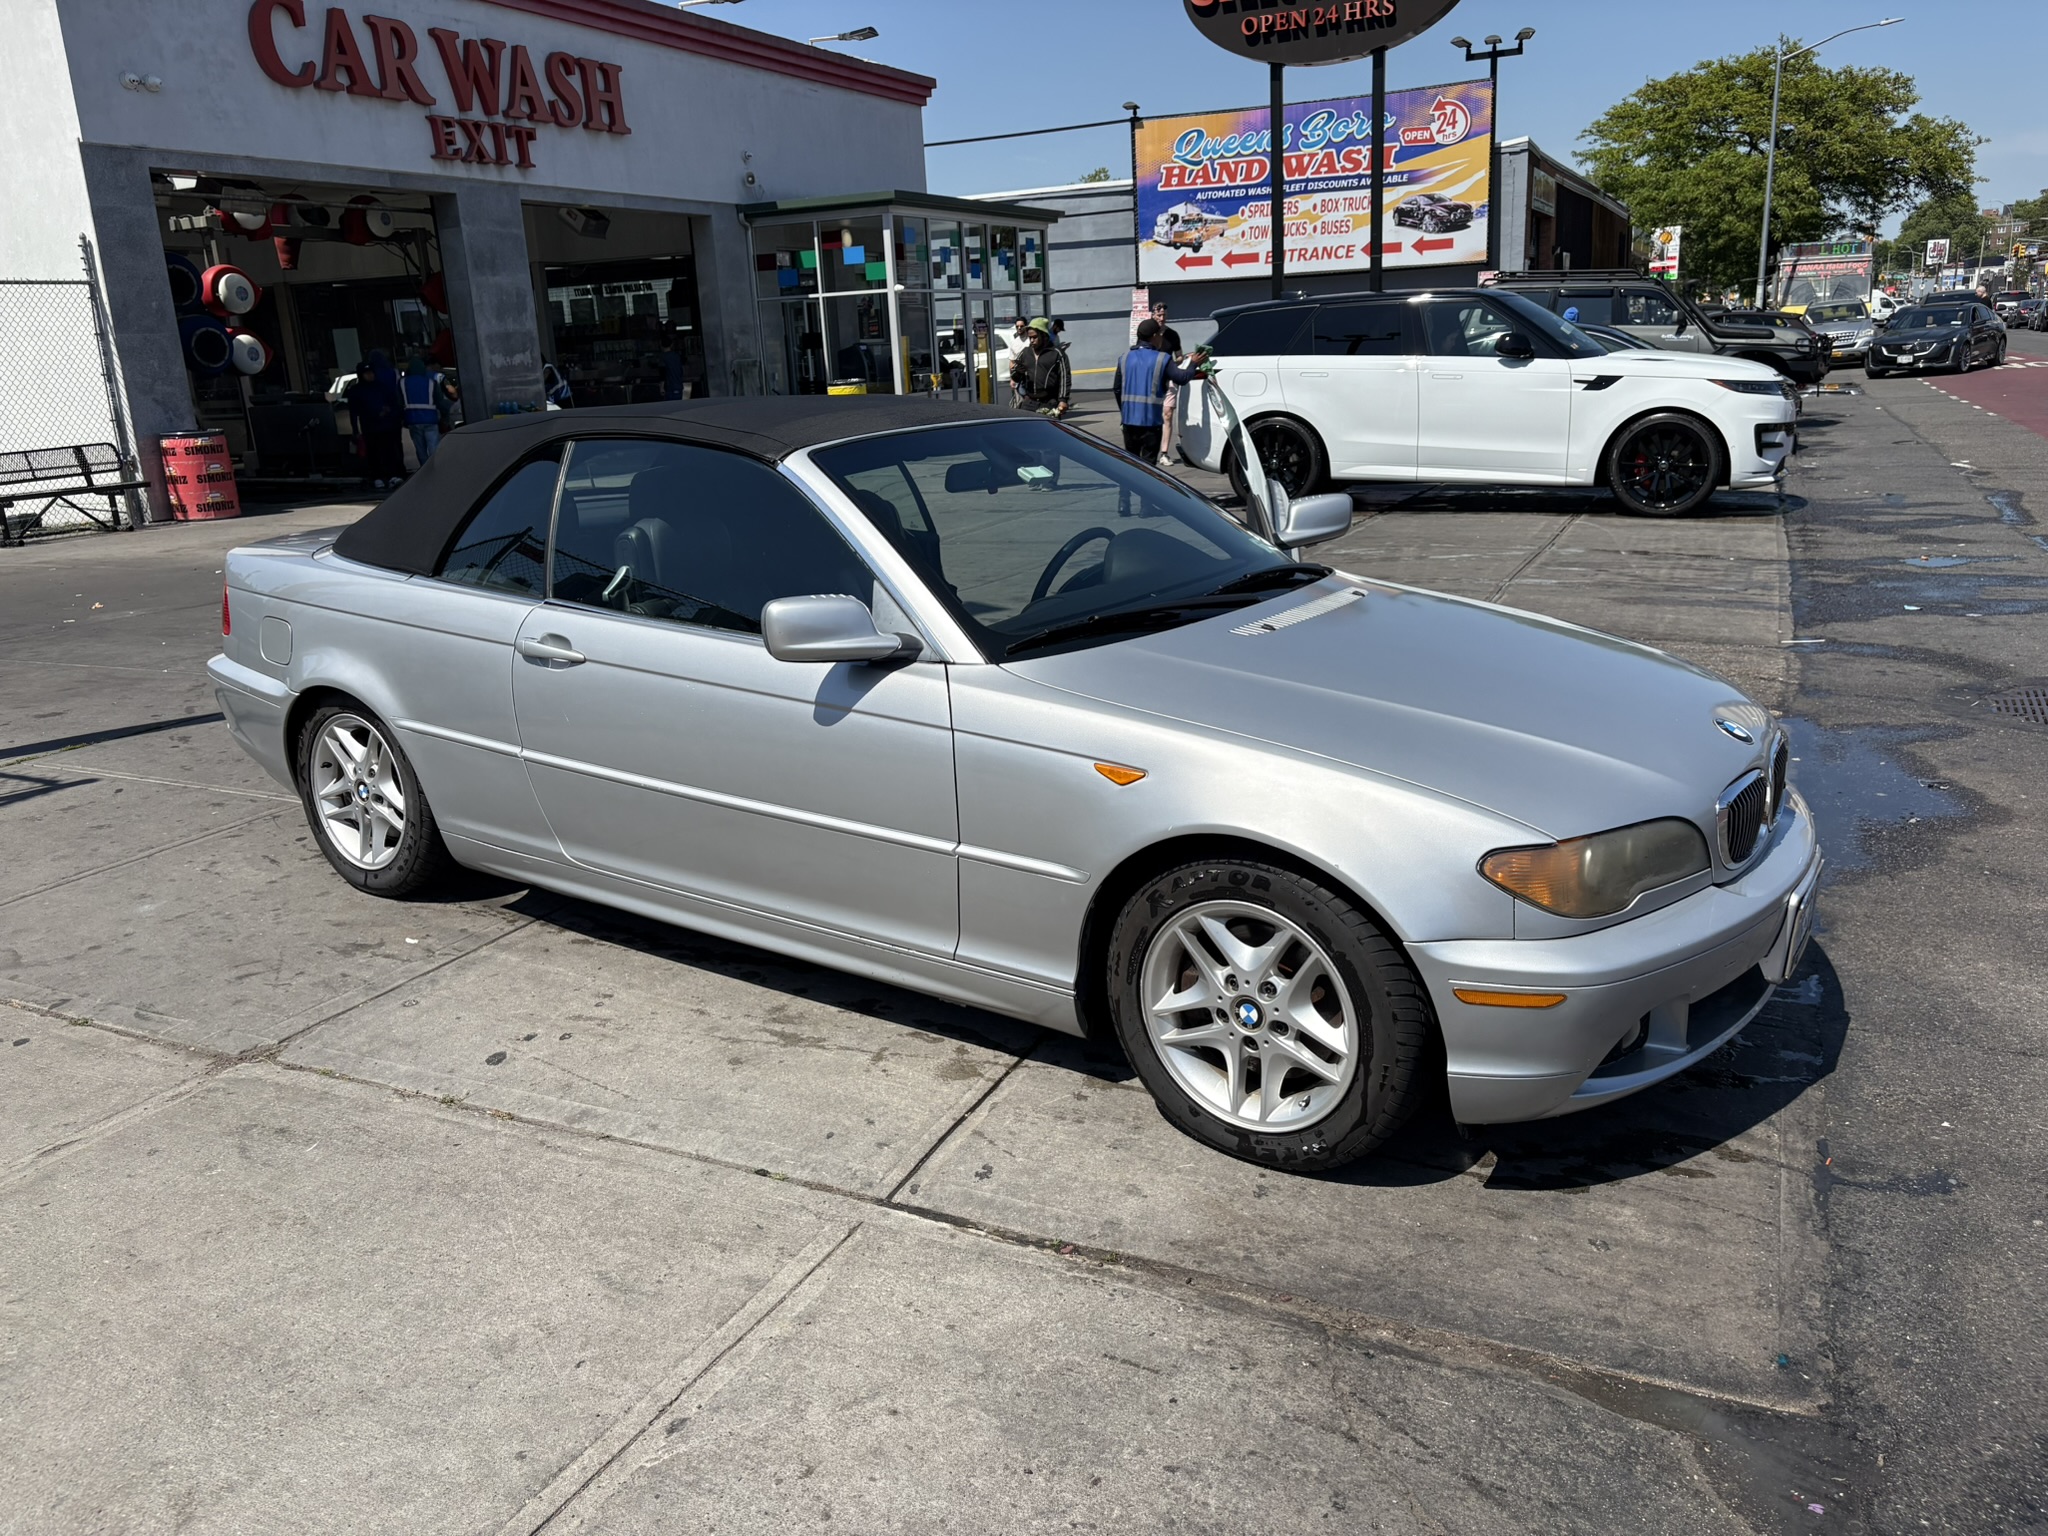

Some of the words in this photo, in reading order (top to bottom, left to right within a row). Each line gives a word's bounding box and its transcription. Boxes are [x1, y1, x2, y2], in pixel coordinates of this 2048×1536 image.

[1241, 9, 1307, 36] OPEN
[1313, 7, 1339, 26] 24
[1343, 0, 1395, 22] HRS
[248, 0, 436, 106] CAR
[428, 27, 632, 135] WASH
[1436, 108, 1458, 135] 24
[425, 114, 537, 169] EXIT
[1404, 130, 1430, 141] OPEN
[1442, 132, 1457, 141] hrs
[1158, 157, 1270, 191] HAND
[1283, 142, 1400, 180] WASH
[1196, 188, 1246, 200] AUTOMATED
[1248, 186, 1272, 196] WASH
[1307, 178, 1359, 190] DISCOUNTS
[1359, 173, 1409, 186] AVLABLE
[1248, 200, 1300, 218] SPRIERS
[1320, 198, 1340, 213] BOX
[1249, 225, 1270, 240] TOW
[1320, 219, 1351, 235] BUSES
[1264, 244, 1356, 264] ETRANCE
[1831, 243, 1858, 254] HOT
[184, 444, 224, 456] SIMONIZ
[196, 500, 235, 513] SIMONIZ
